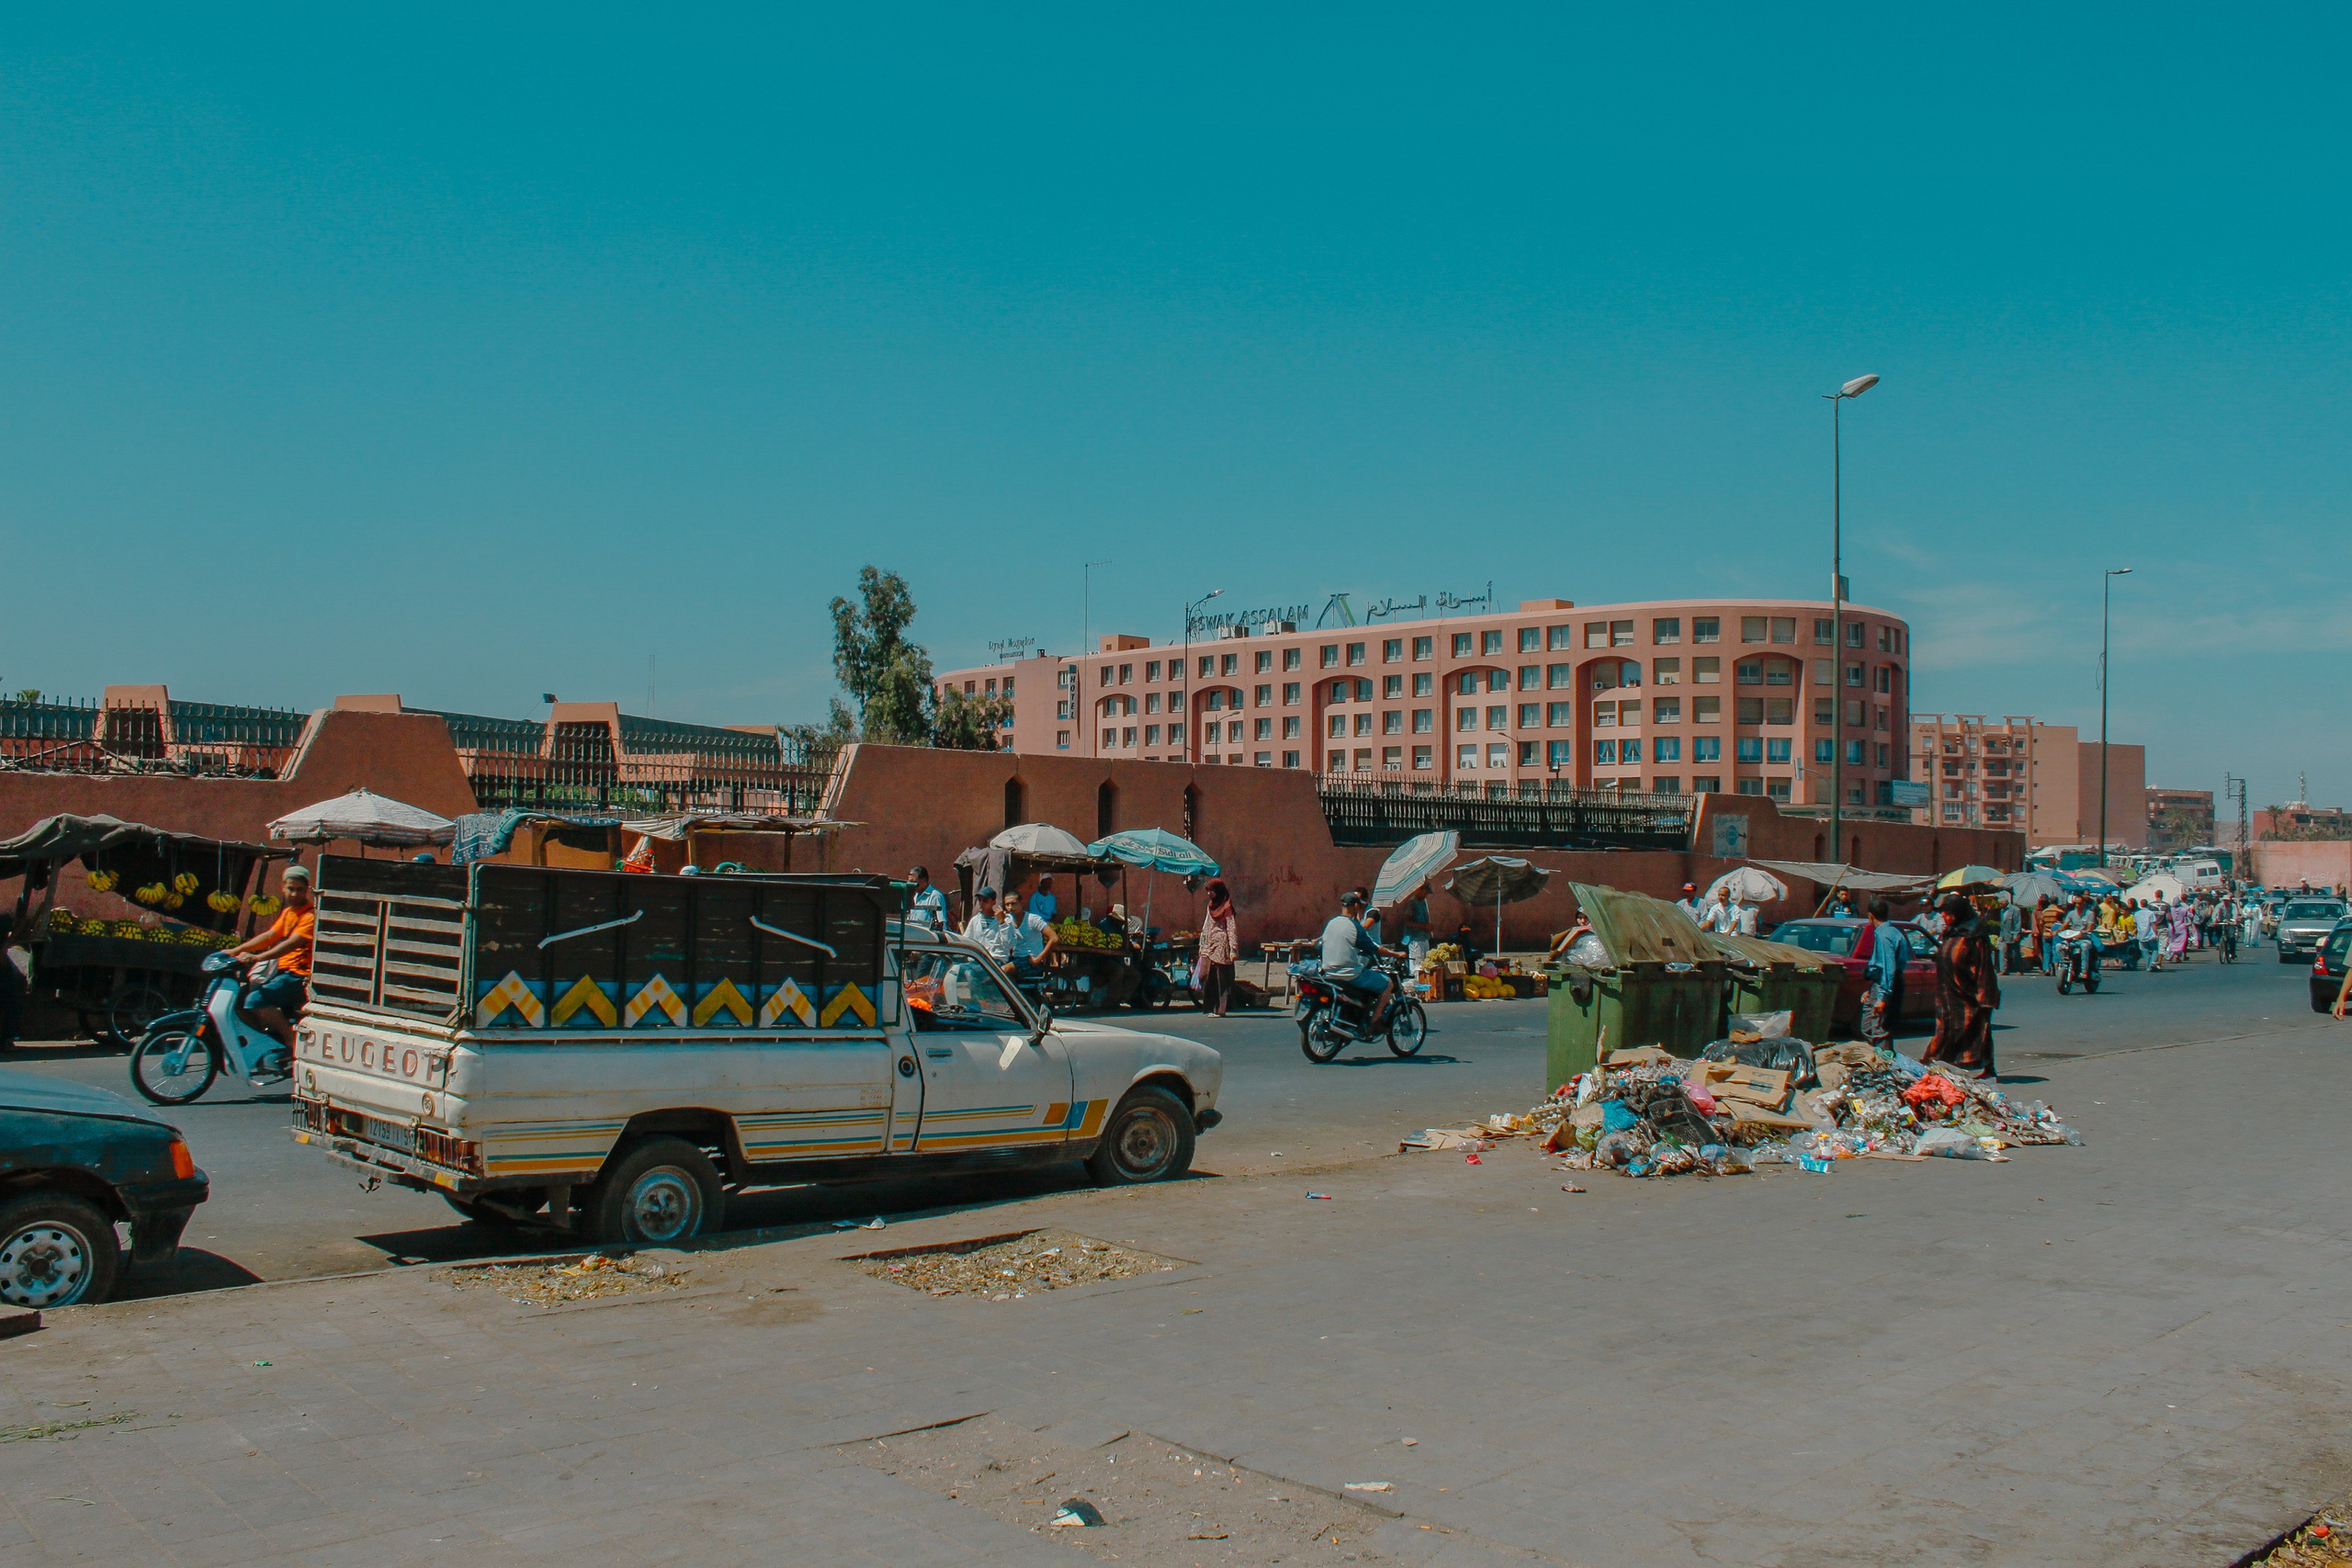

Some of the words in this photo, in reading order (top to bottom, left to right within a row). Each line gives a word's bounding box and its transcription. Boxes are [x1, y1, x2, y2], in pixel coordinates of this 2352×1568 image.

[1190, 613, 1235, 631] ASWAK
[1238, 604, 1309, 626] ASSALAM
[1365, 594, 1427, 625] السلام
[1158, 848, 1177, 858] Sidi
[1179, 851, 1192, 860] ali
